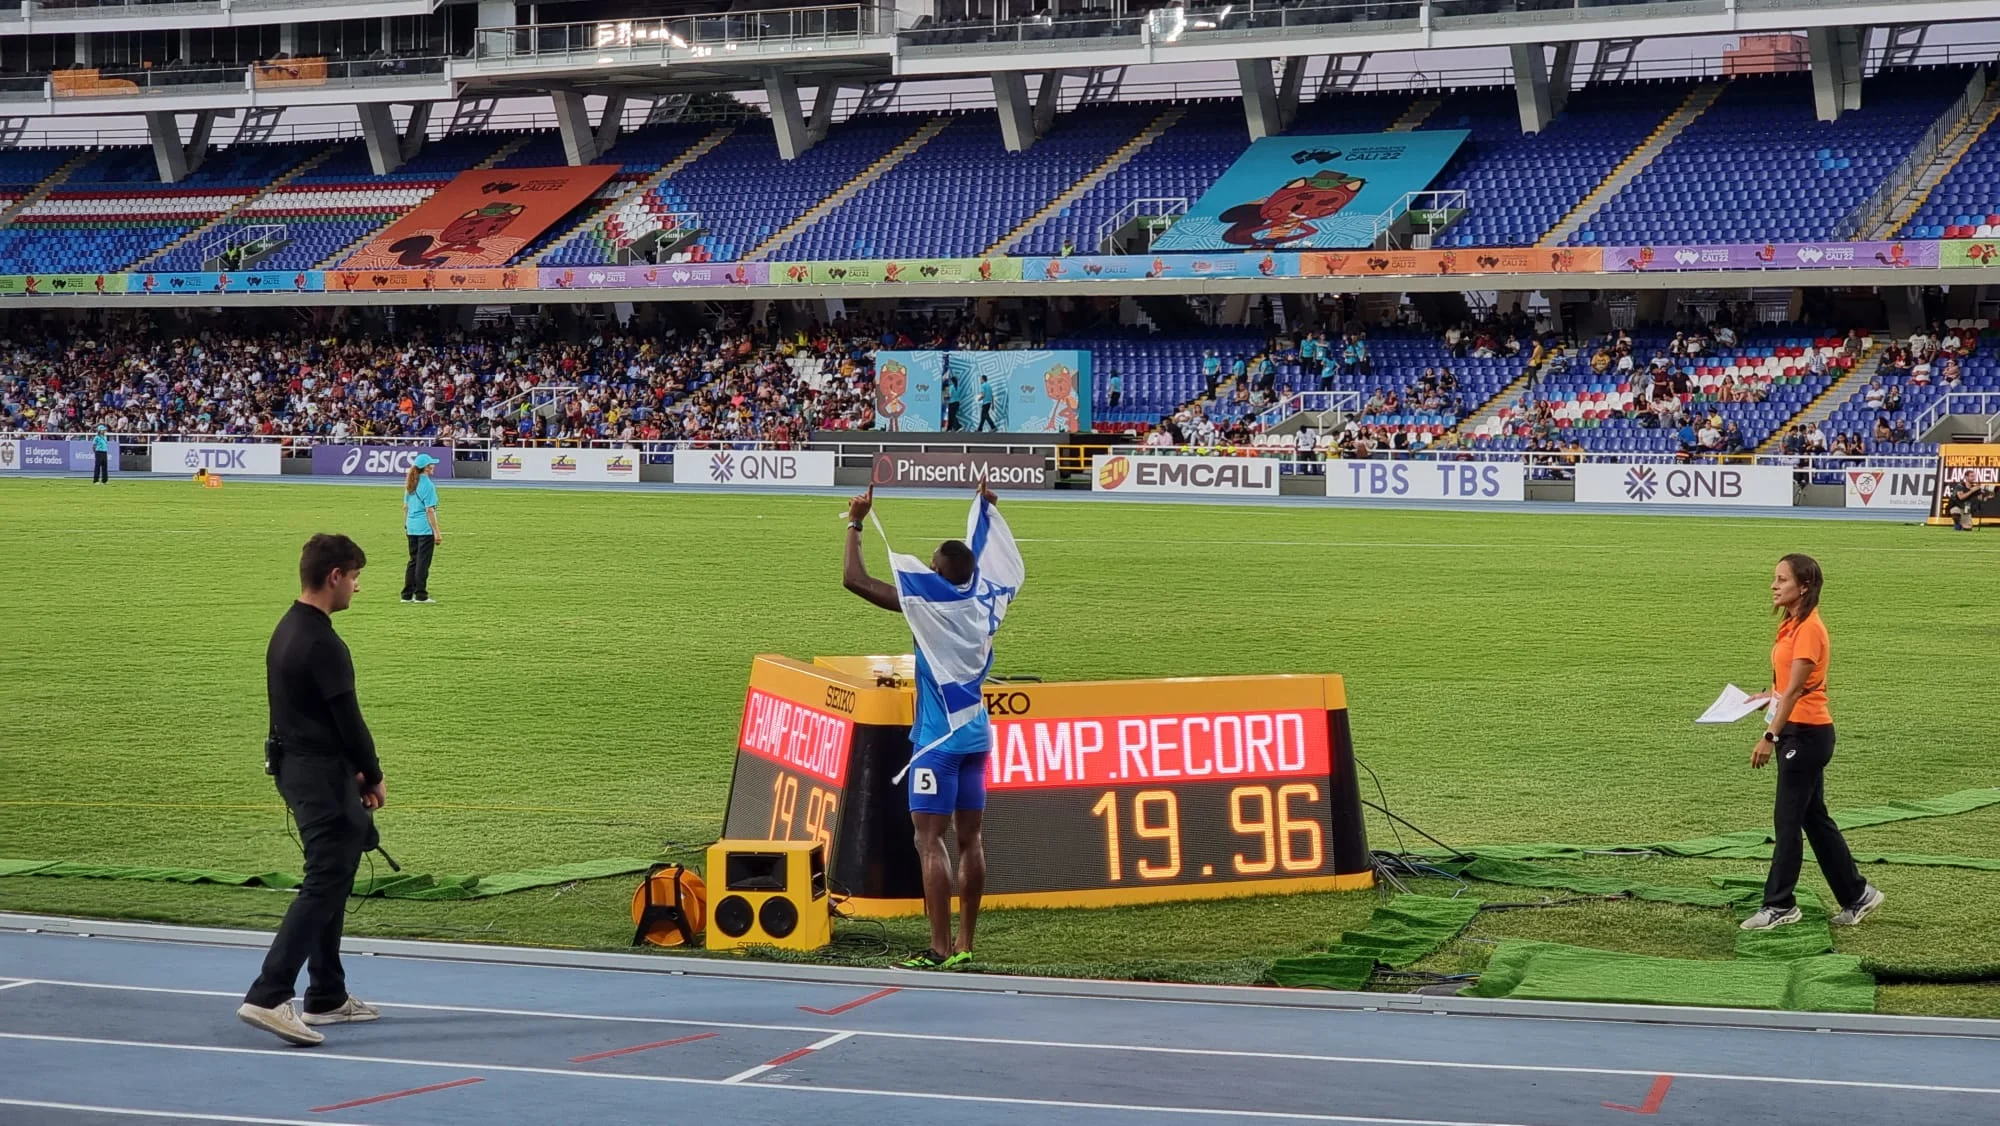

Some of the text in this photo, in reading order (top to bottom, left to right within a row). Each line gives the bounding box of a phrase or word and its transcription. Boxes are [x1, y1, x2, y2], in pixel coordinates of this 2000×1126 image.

[26, 447, 58, 456] El deporte
[200, 449, 246, 468] TDK
[1946, 456, 1976, 467] HAMMER
[1980, 456, 1985, 466] M
[740, 455, 797, 480] QNB
[897, 460, 1044, 484] Pinsent Masons
[1136, 462, 1272, 489] EMCALI
[1348, 463, 1410, 495] TBS
[1436, 465, 1500, 497] TBS
[1666, 470, 1742, 498] QNB
[825, 685, 855, 714] SEIKO
[921, 773, 931, 790] 5
